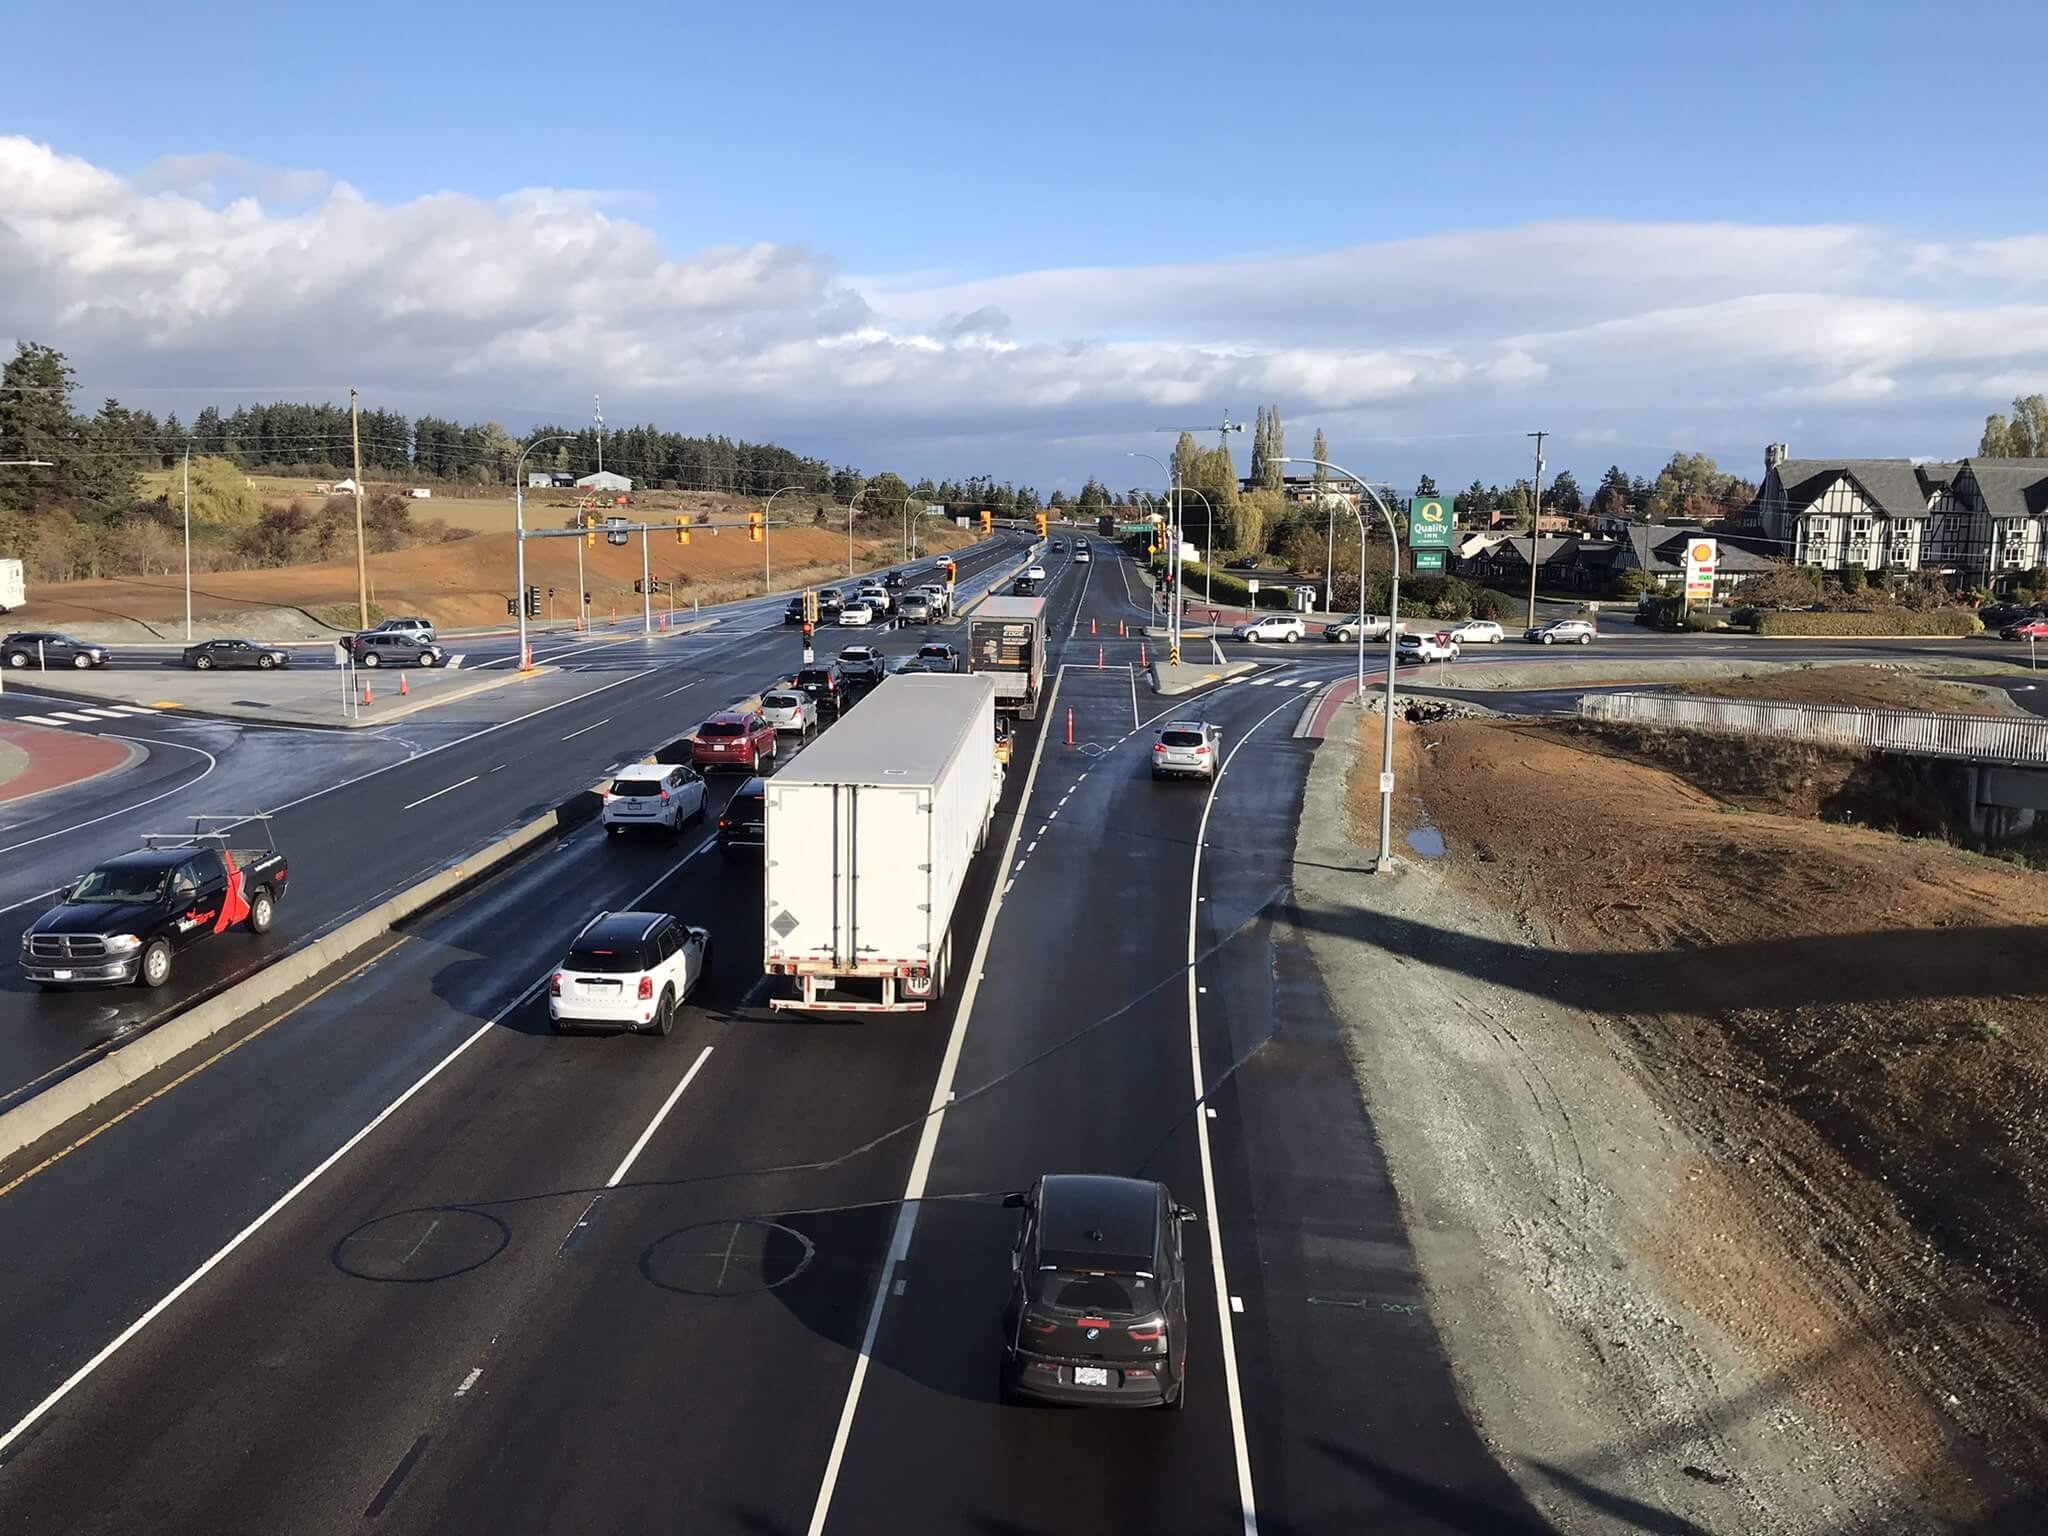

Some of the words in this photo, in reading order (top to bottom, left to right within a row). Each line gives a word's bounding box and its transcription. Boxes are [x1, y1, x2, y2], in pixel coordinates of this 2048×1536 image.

[1422, 502, 1443, 521] Q
[1414, 523, 1448, 534] Quality
[910, 977, 929, 988] TIP
